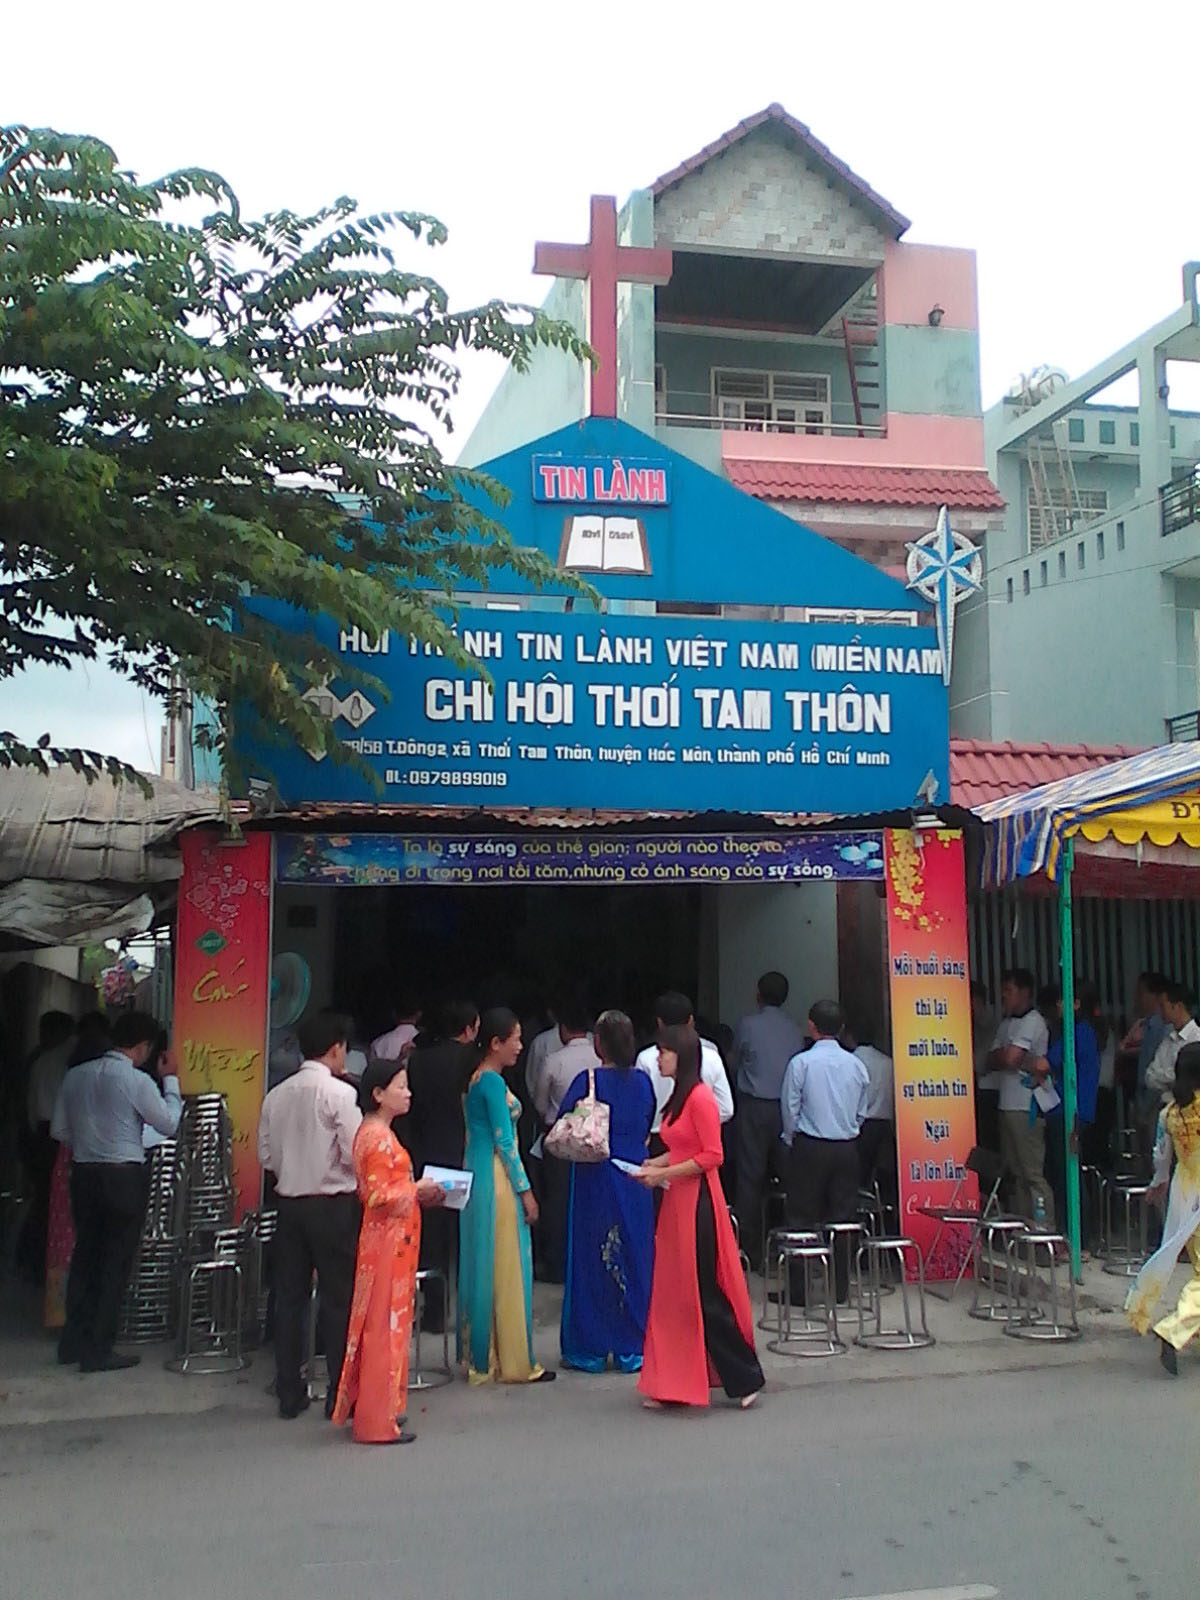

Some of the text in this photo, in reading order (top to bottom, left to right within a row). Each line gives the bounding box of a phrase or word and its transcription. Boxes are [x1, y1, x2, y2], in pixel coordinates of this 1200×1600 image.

[540, 459, 667, 502] TIN LÀNH
[517, 631, 563, 662] TIN
[576, 628, 652, 665] LÀNH
[666, 634, 727, 671] VIỆT
[740, 642, 799, 670] NAM
[811, 634, 881, 673] (MIỀN
[425, 672, 892, 734] CHI HỘI THỚI TAM THÔN
[452, 741, 471, 757] xã
[518, 744, 547, 760] Tam
[599, 744, 642, 765] huyện
[648, 742, 676, 761] Hóc
[717, 743, 761, 763] thành
[767, 741, 795, 765] phố
[801, 741, 820, 764] Hồ
[827, 745, 851, 765] Chí
[856, 750, 891, 766] Minh
[403, 839, 421, 853] Ta
[428, 839, 443, 854] là
[448, 841, 470, 858] sự
[475, 838, 517, 857] sáng
[522, 839, 551, 854] của
[556, 836, 583, 854] thế
[636, 839, 682, 857] người
[686, 840, 718, 854] nào
[723, 839, 760, 854] theo
[405, 864, 421, 879] đi
[426, 865, 473, 882] trong
[478, 865, 503, 879] nơi
[508, 861, 531, 878] tối
[653, 863, 685, 878] ánh
[690, 863, 730, 881] sáng
[735, 861, 763, 877] của
[768, 864, 788, 880] sự
[894, 952, 966, 980] Mỗi buổi sáng
[934, 998, 948, 1020] lại
[903, 1078, 968, 1101] sự thành tín
[925, 1119, 949, 1142] Ngài
